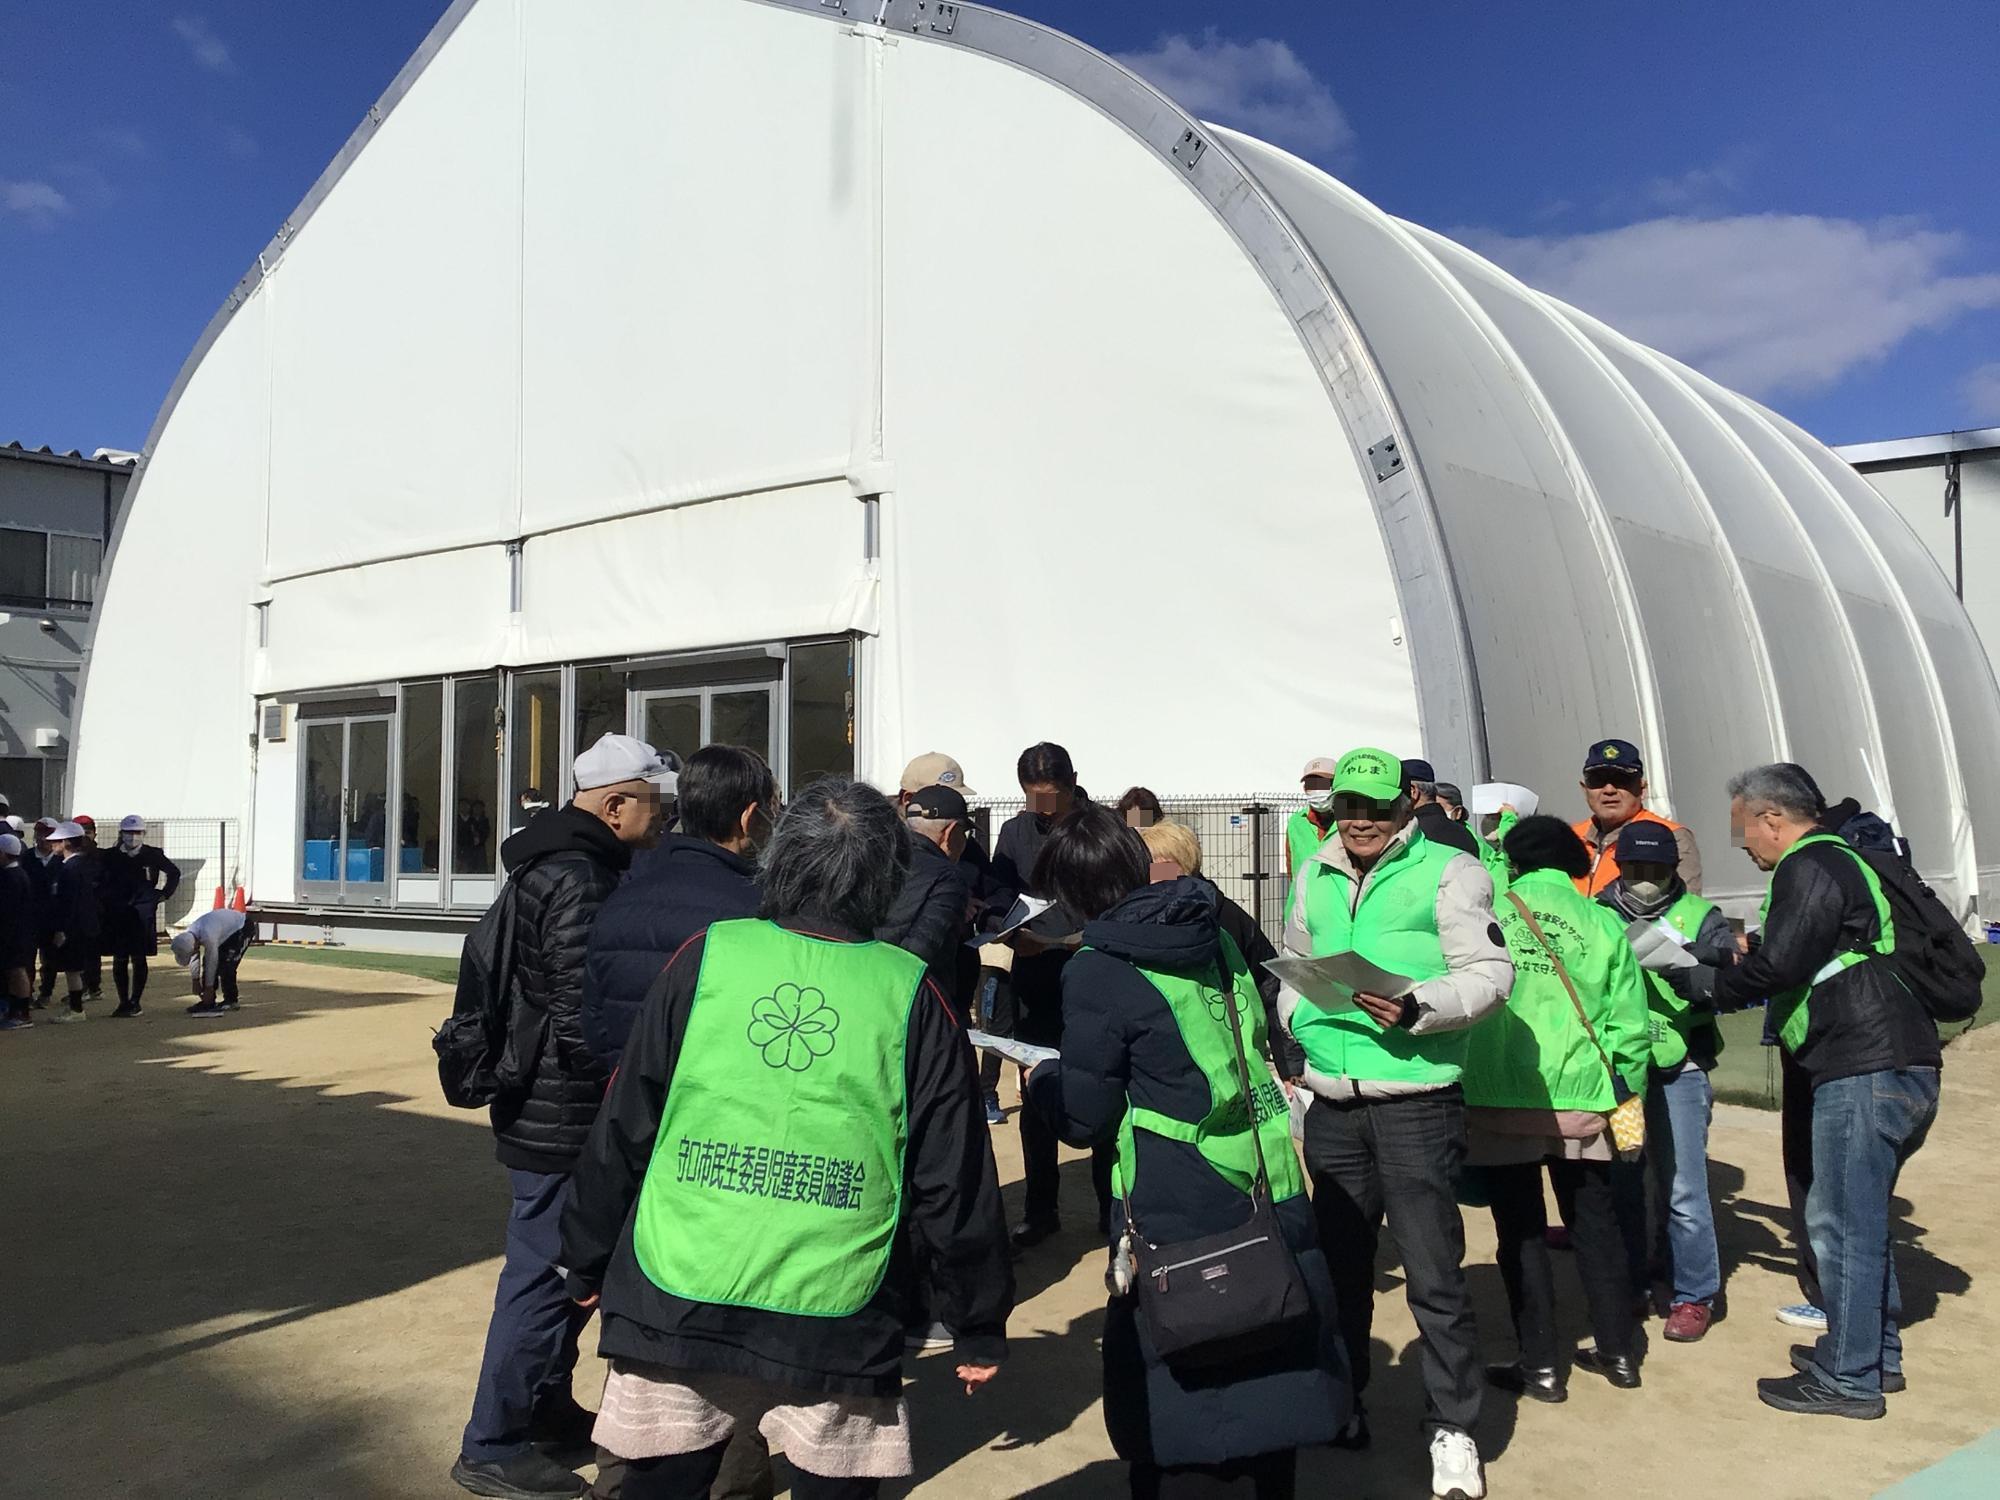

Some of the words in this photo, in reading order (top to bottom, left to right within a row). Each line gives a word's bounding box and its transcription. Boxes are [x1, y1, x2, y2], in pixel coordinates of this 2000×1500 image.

[1347, 765, 1380, 775] やしま
[677, 1134, 866, 1212] 守口市民生委員児童委員協議会
